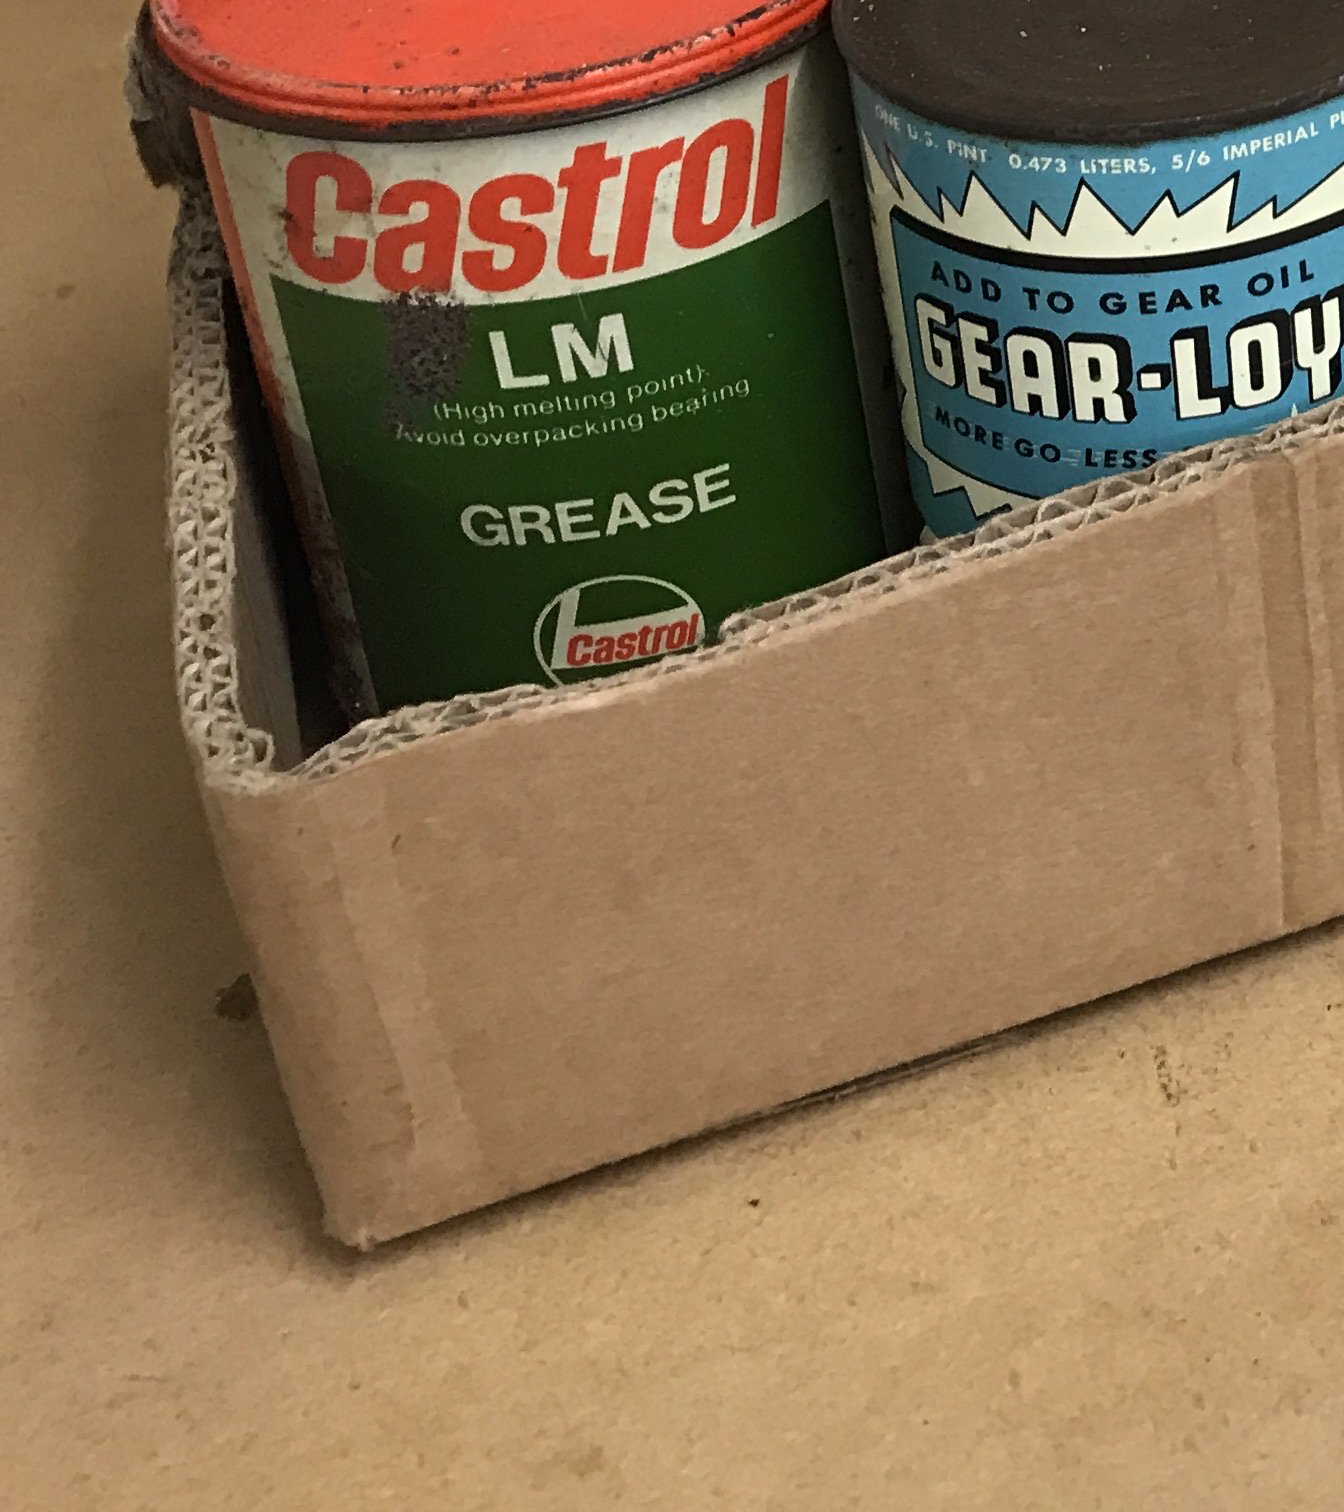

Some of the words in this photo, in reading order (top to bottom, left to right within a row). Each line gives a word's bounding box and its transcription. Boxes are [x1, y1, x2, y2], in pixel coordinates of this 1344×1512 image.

[875, 104, 901, 132] ONE
[946, 139, 988, 164] PINT
[1008, 153, 1067, 174] 0.473
[1079, 157, 1157, 176] LITERS,
[1172, 149, 1210, 173] 5/6
[1222, 121, 1320, 162] IMPERIAL
[282, 74, 791, 294] Castrol
[931, 259, 1002, 305] ADD
[1021, 285, 1074, 315] TO
[1099, 284, 1222, 316] GEAR
[1247, 259, 1316, 299] OIL
[487, 313, 636, 390] LM
[433, 401, 505, 424] (High
[512, 390, 617, 416] melting
[472, 412, 645, 448] overpacking
[651, 377, 751, 423] bearing
[934, 405, 1004, 451] MORE
[1014, 437, 1062, 463] GO
[1085, 447, 1158, 469] LESS
[460, 463, 738, 549] GREASE
[566, 612, 701, 669] Castrol
